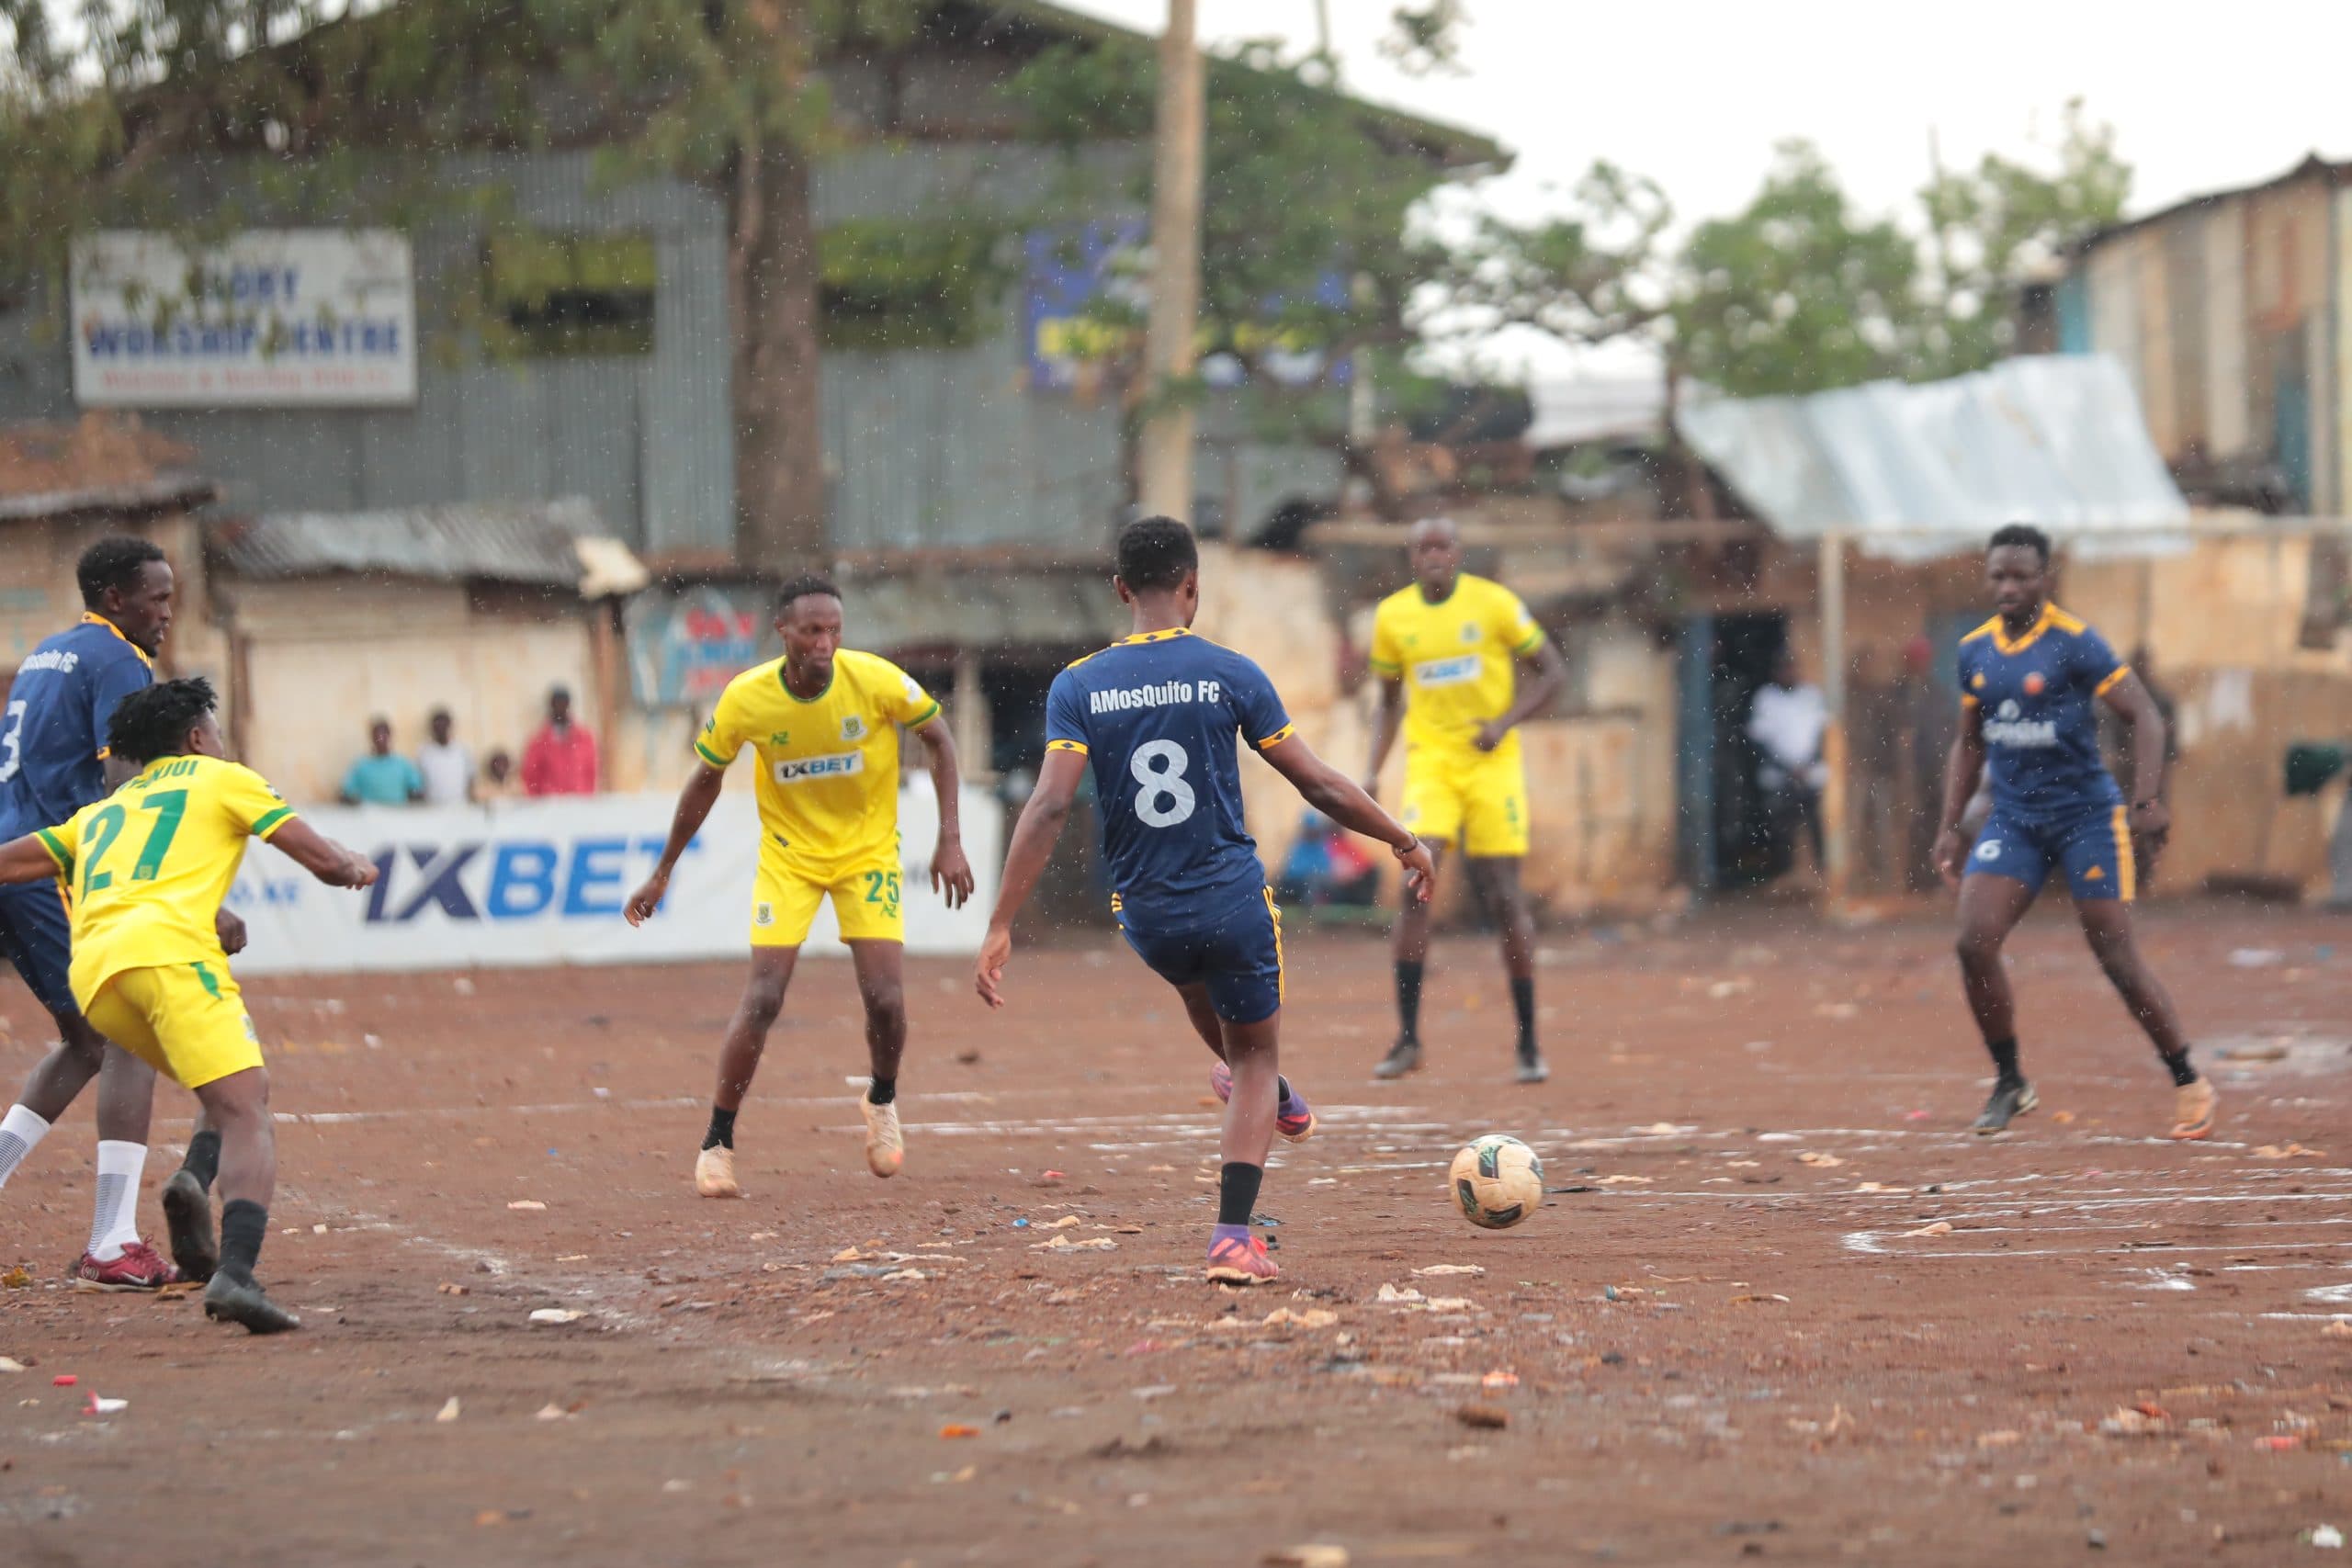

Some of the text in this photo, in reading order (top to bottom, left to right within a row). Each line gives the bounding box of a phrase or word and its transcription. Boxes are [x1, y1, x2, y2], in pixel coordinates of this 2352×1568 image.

[1091, 680, 1220, 714] AMosQuito FC
[781, 754, 857, 778] 1XBET
[1130, 739, 1194, 828] 8
[81, 789, 188, 905] 27
[1975, 839, 2002, 862] 6
[366, 840, 700, 923] 1XBET
[865, 870, 899, 903] 25
